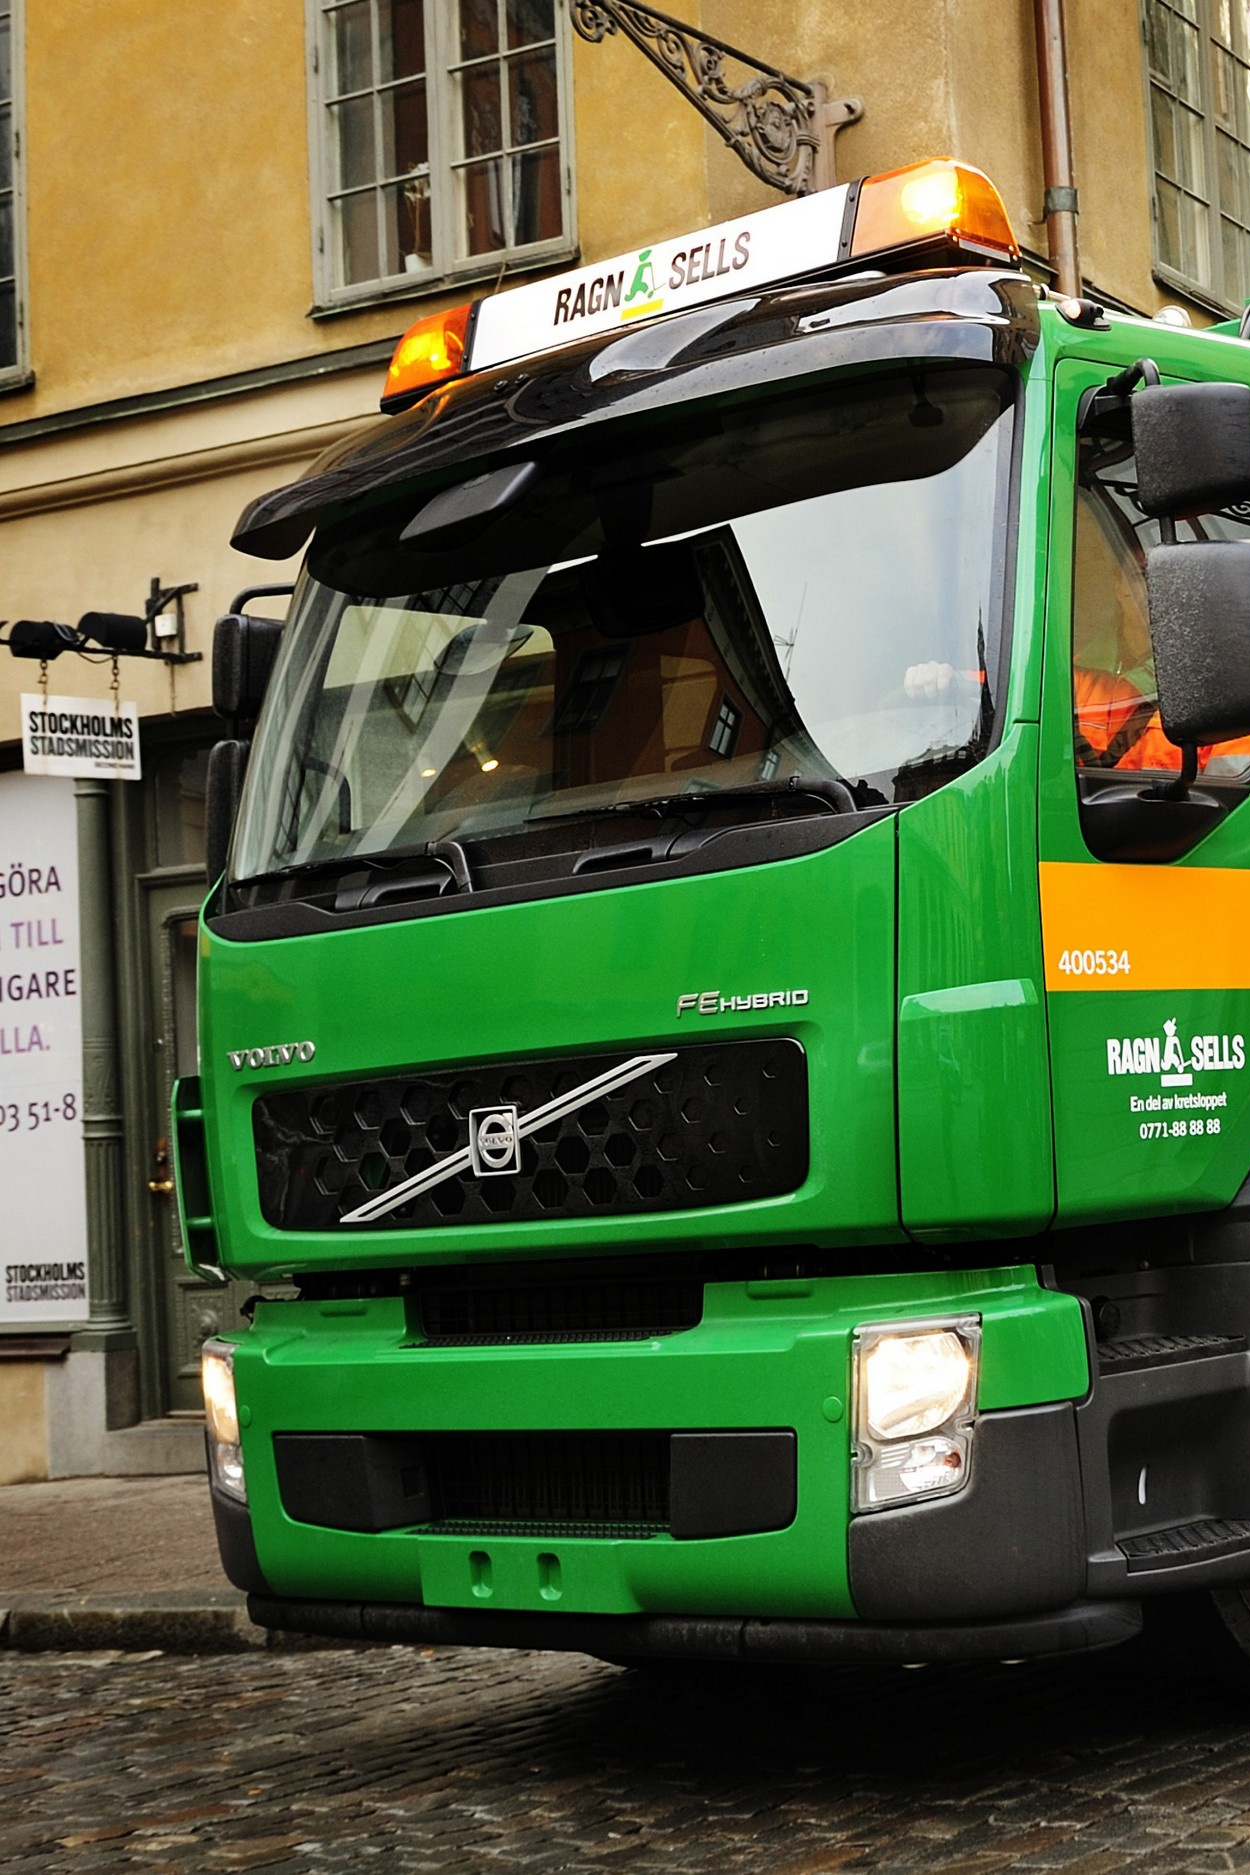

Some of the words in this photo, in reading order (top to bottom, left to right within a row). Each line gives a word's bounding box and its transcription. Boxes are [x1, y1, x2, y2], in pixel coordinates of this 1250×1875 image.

[553, 270, 625, 326] RAGN
[668, 231, 750, 290] SELLS
[29, 711, 133, 739] STOCKHOLMS
[30, 736, 135, 760] STADSMISSION
[10, 918, 63, 949] TILL
[1058, 950, 1131, 975] 400534
[226, 1041, 316, 1071] VOLVO
[1106, 1037, 1160, 1075] RAGN
[1190, 1035, 1246, 1071] SELLS
[1130, 1096, 1145, 1112] En
[1145, 1094, 1161, 1111] del
[1162, 1099, 1174, 1110] av
[1174, 1091, 1228, 1111] kretsloppet
[1139, 1121, 1187, 1139] 0771-88
[1189, 1120, 1204, 1136] 88
[1206, 1118, 1221, 1134] 88
[6, 1262, 85, 1283] STOCKHOLMS
